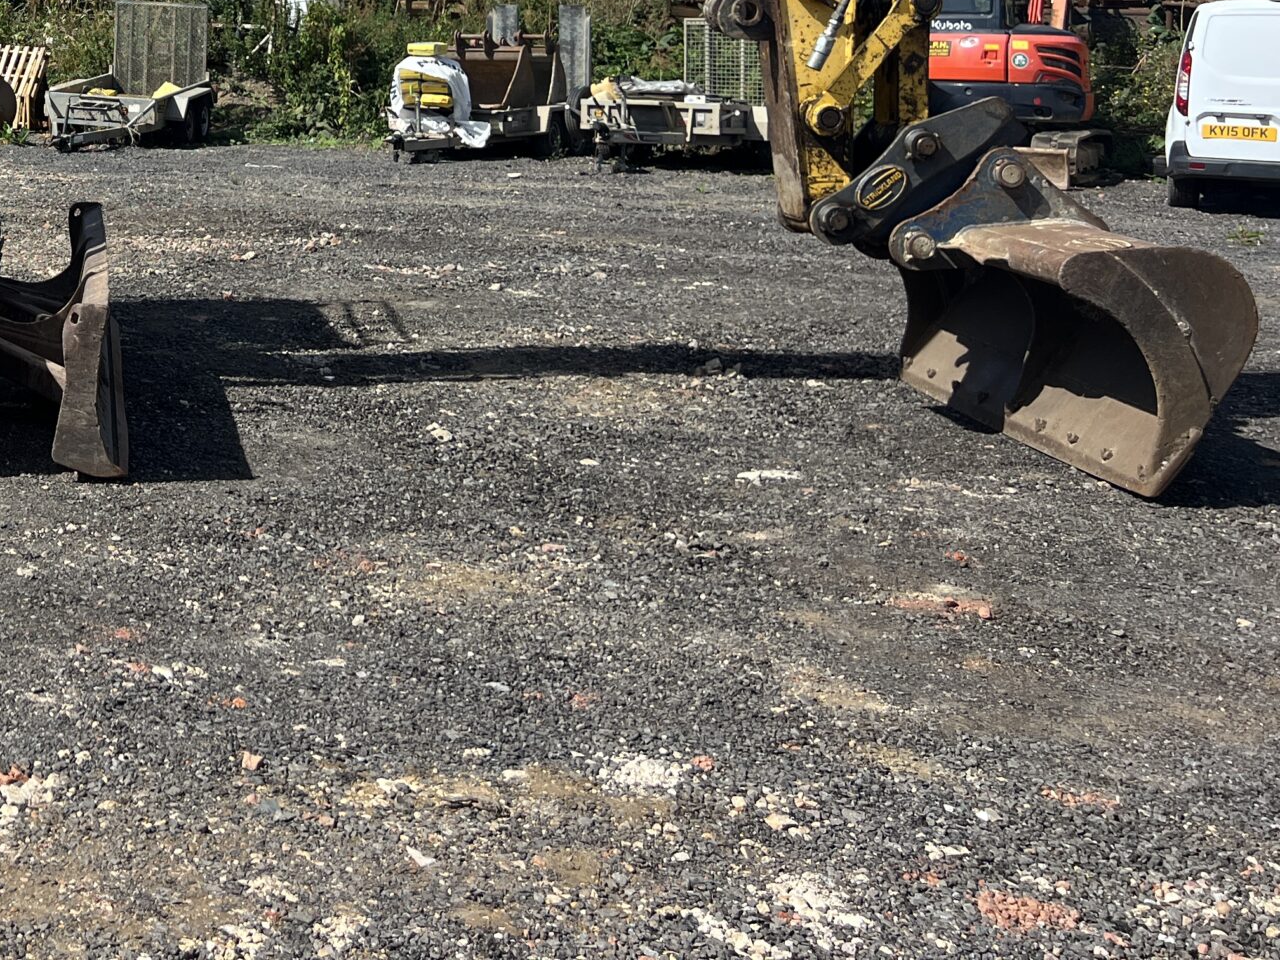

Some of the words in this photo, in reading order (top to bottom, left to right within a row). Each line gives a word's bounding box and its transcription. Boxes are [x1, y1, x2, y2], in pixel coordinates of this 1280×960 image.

[931, 19, 972, 30] Kubota
[1209, 125, 1239, 137] KY15
[1242, 126, 1269, 139] OFK
[862, 171, 903, 206] STRICKLAND
